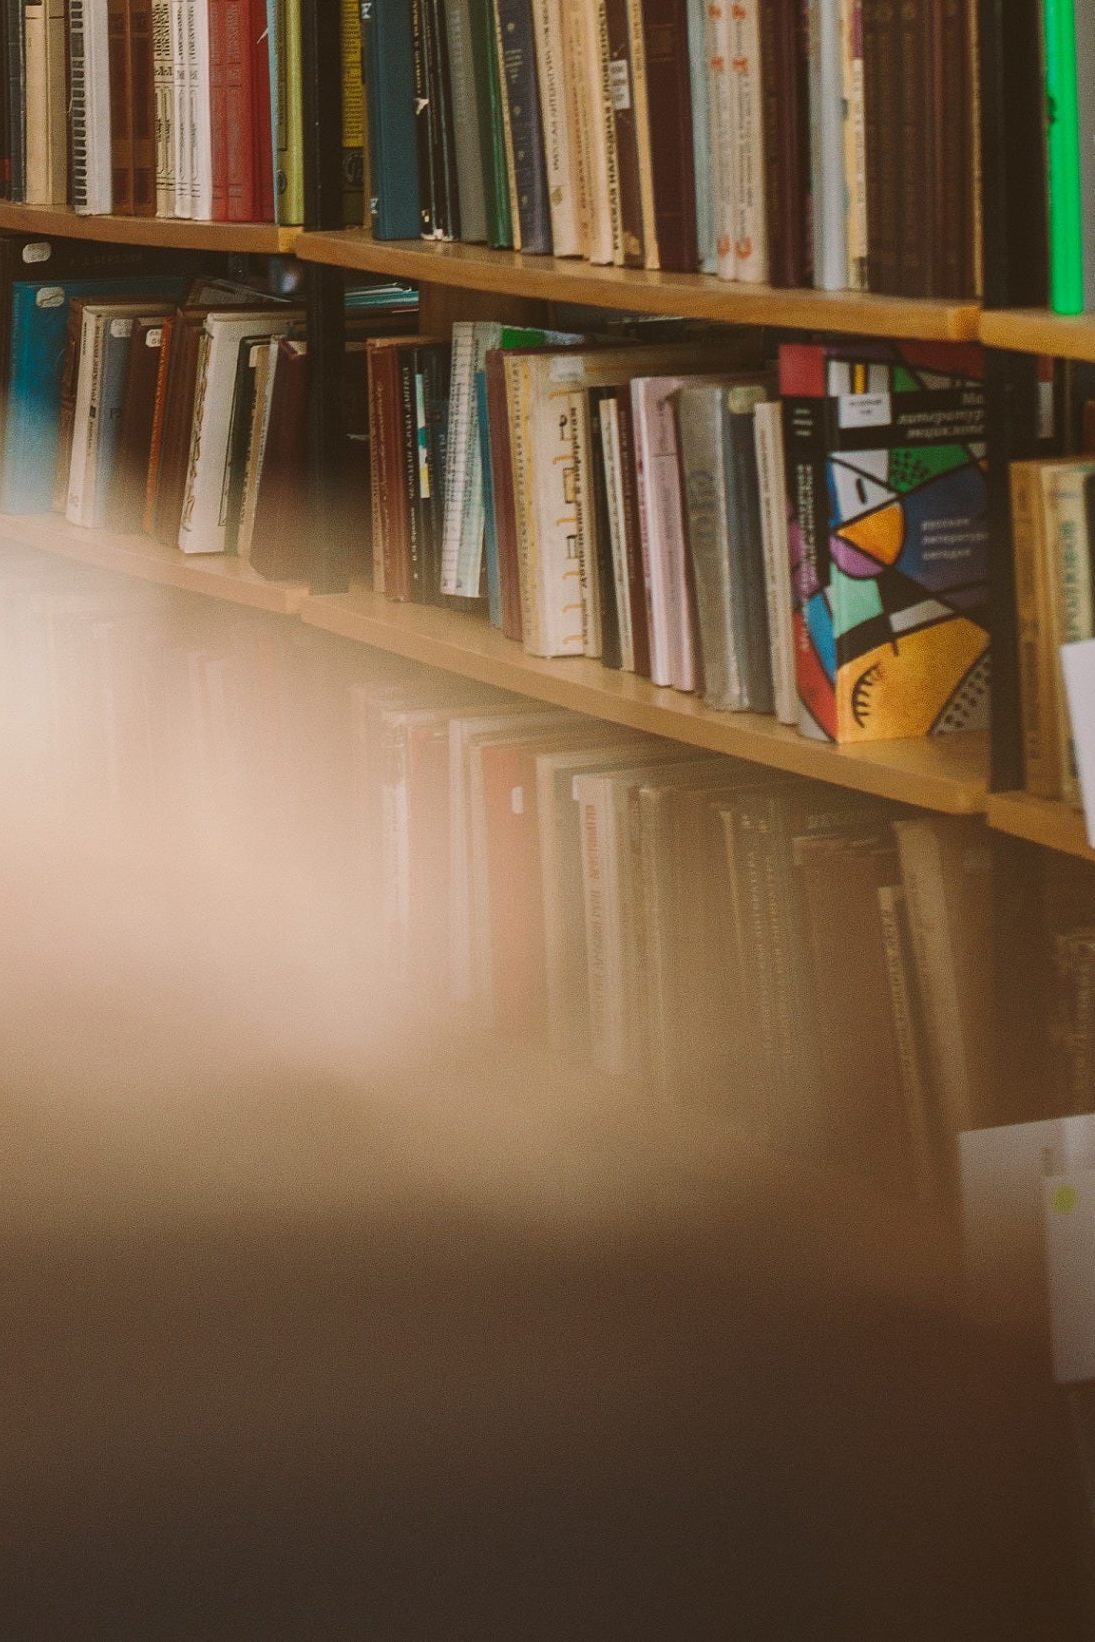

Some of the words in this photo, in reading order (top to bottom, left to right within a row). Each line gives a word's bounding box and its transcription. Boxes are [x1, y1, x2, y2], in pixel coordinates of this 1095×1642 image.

[598, 1, 611, 103] СЛОВЕСНОСТЬ
[604, 106, 617, 184] НАРОДНАЯ
[609, 187, 619, 251] РУССКАЯ
